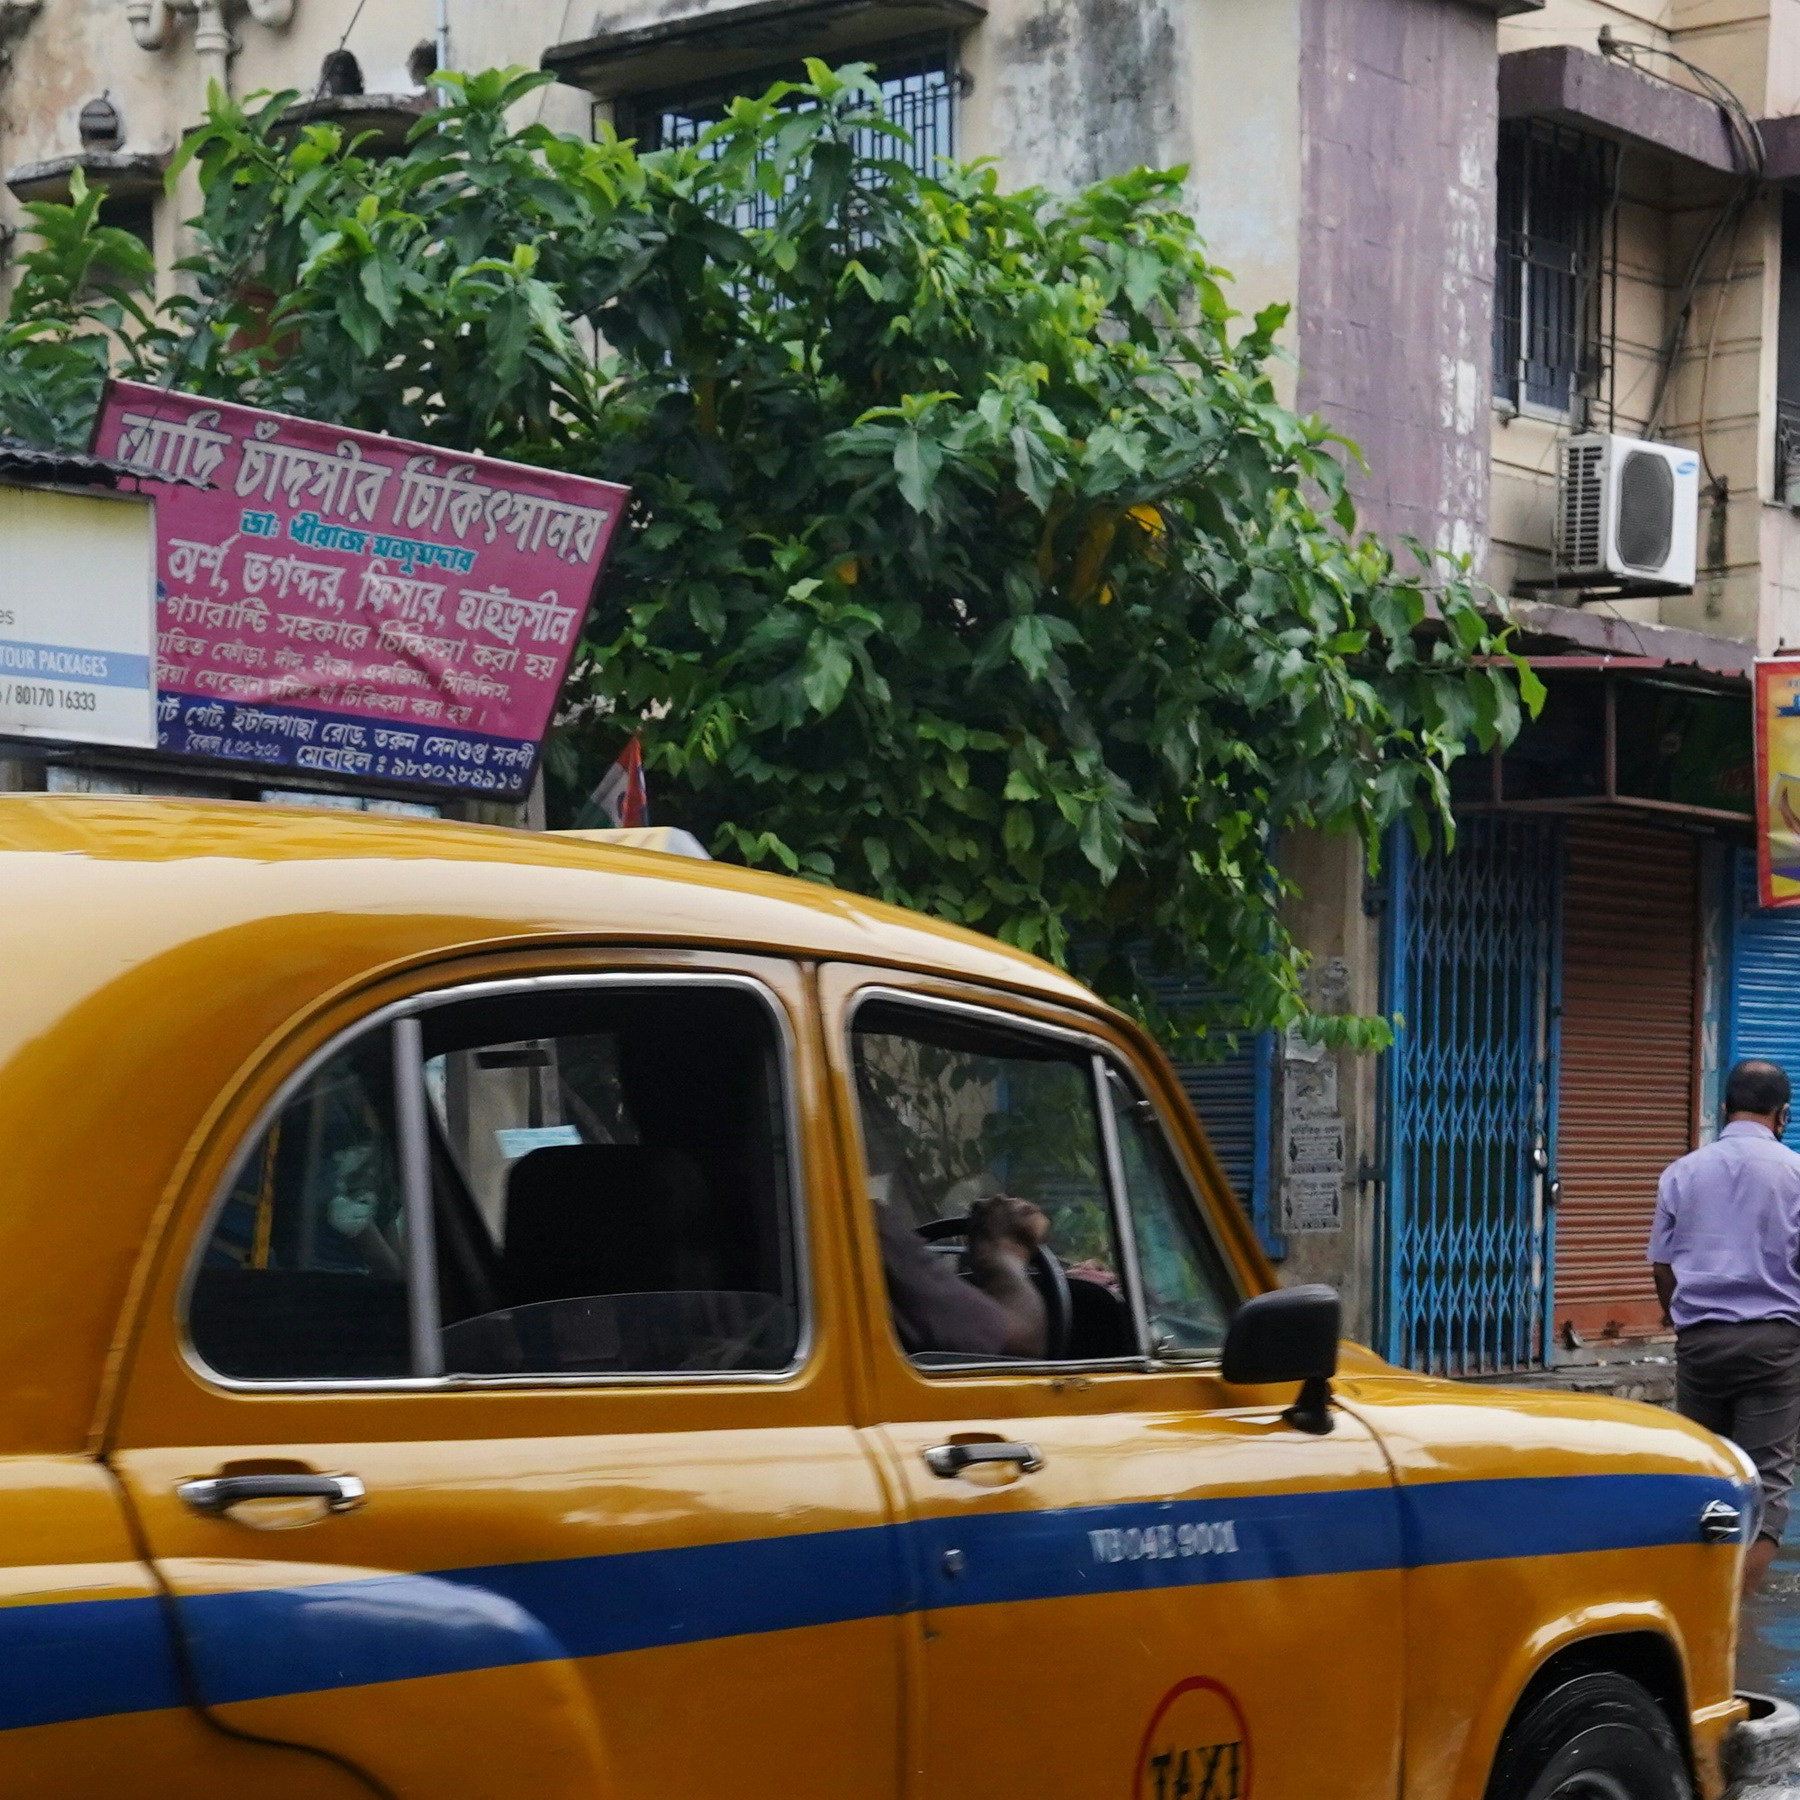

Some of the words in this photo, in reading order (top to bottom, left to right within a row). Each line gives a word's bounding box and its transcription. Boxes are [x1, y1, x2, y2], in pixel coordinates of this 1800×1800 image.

[392, 454, 609, 565] চিকিৎসালয়
[39, 650, 107, 678] PACKAGES
[472, 643, 520, 672] করা
[524, 653, 557, 680] হয়
[15, 685, 53, 708] 80170
[59, 688, 96, 711] 16333
